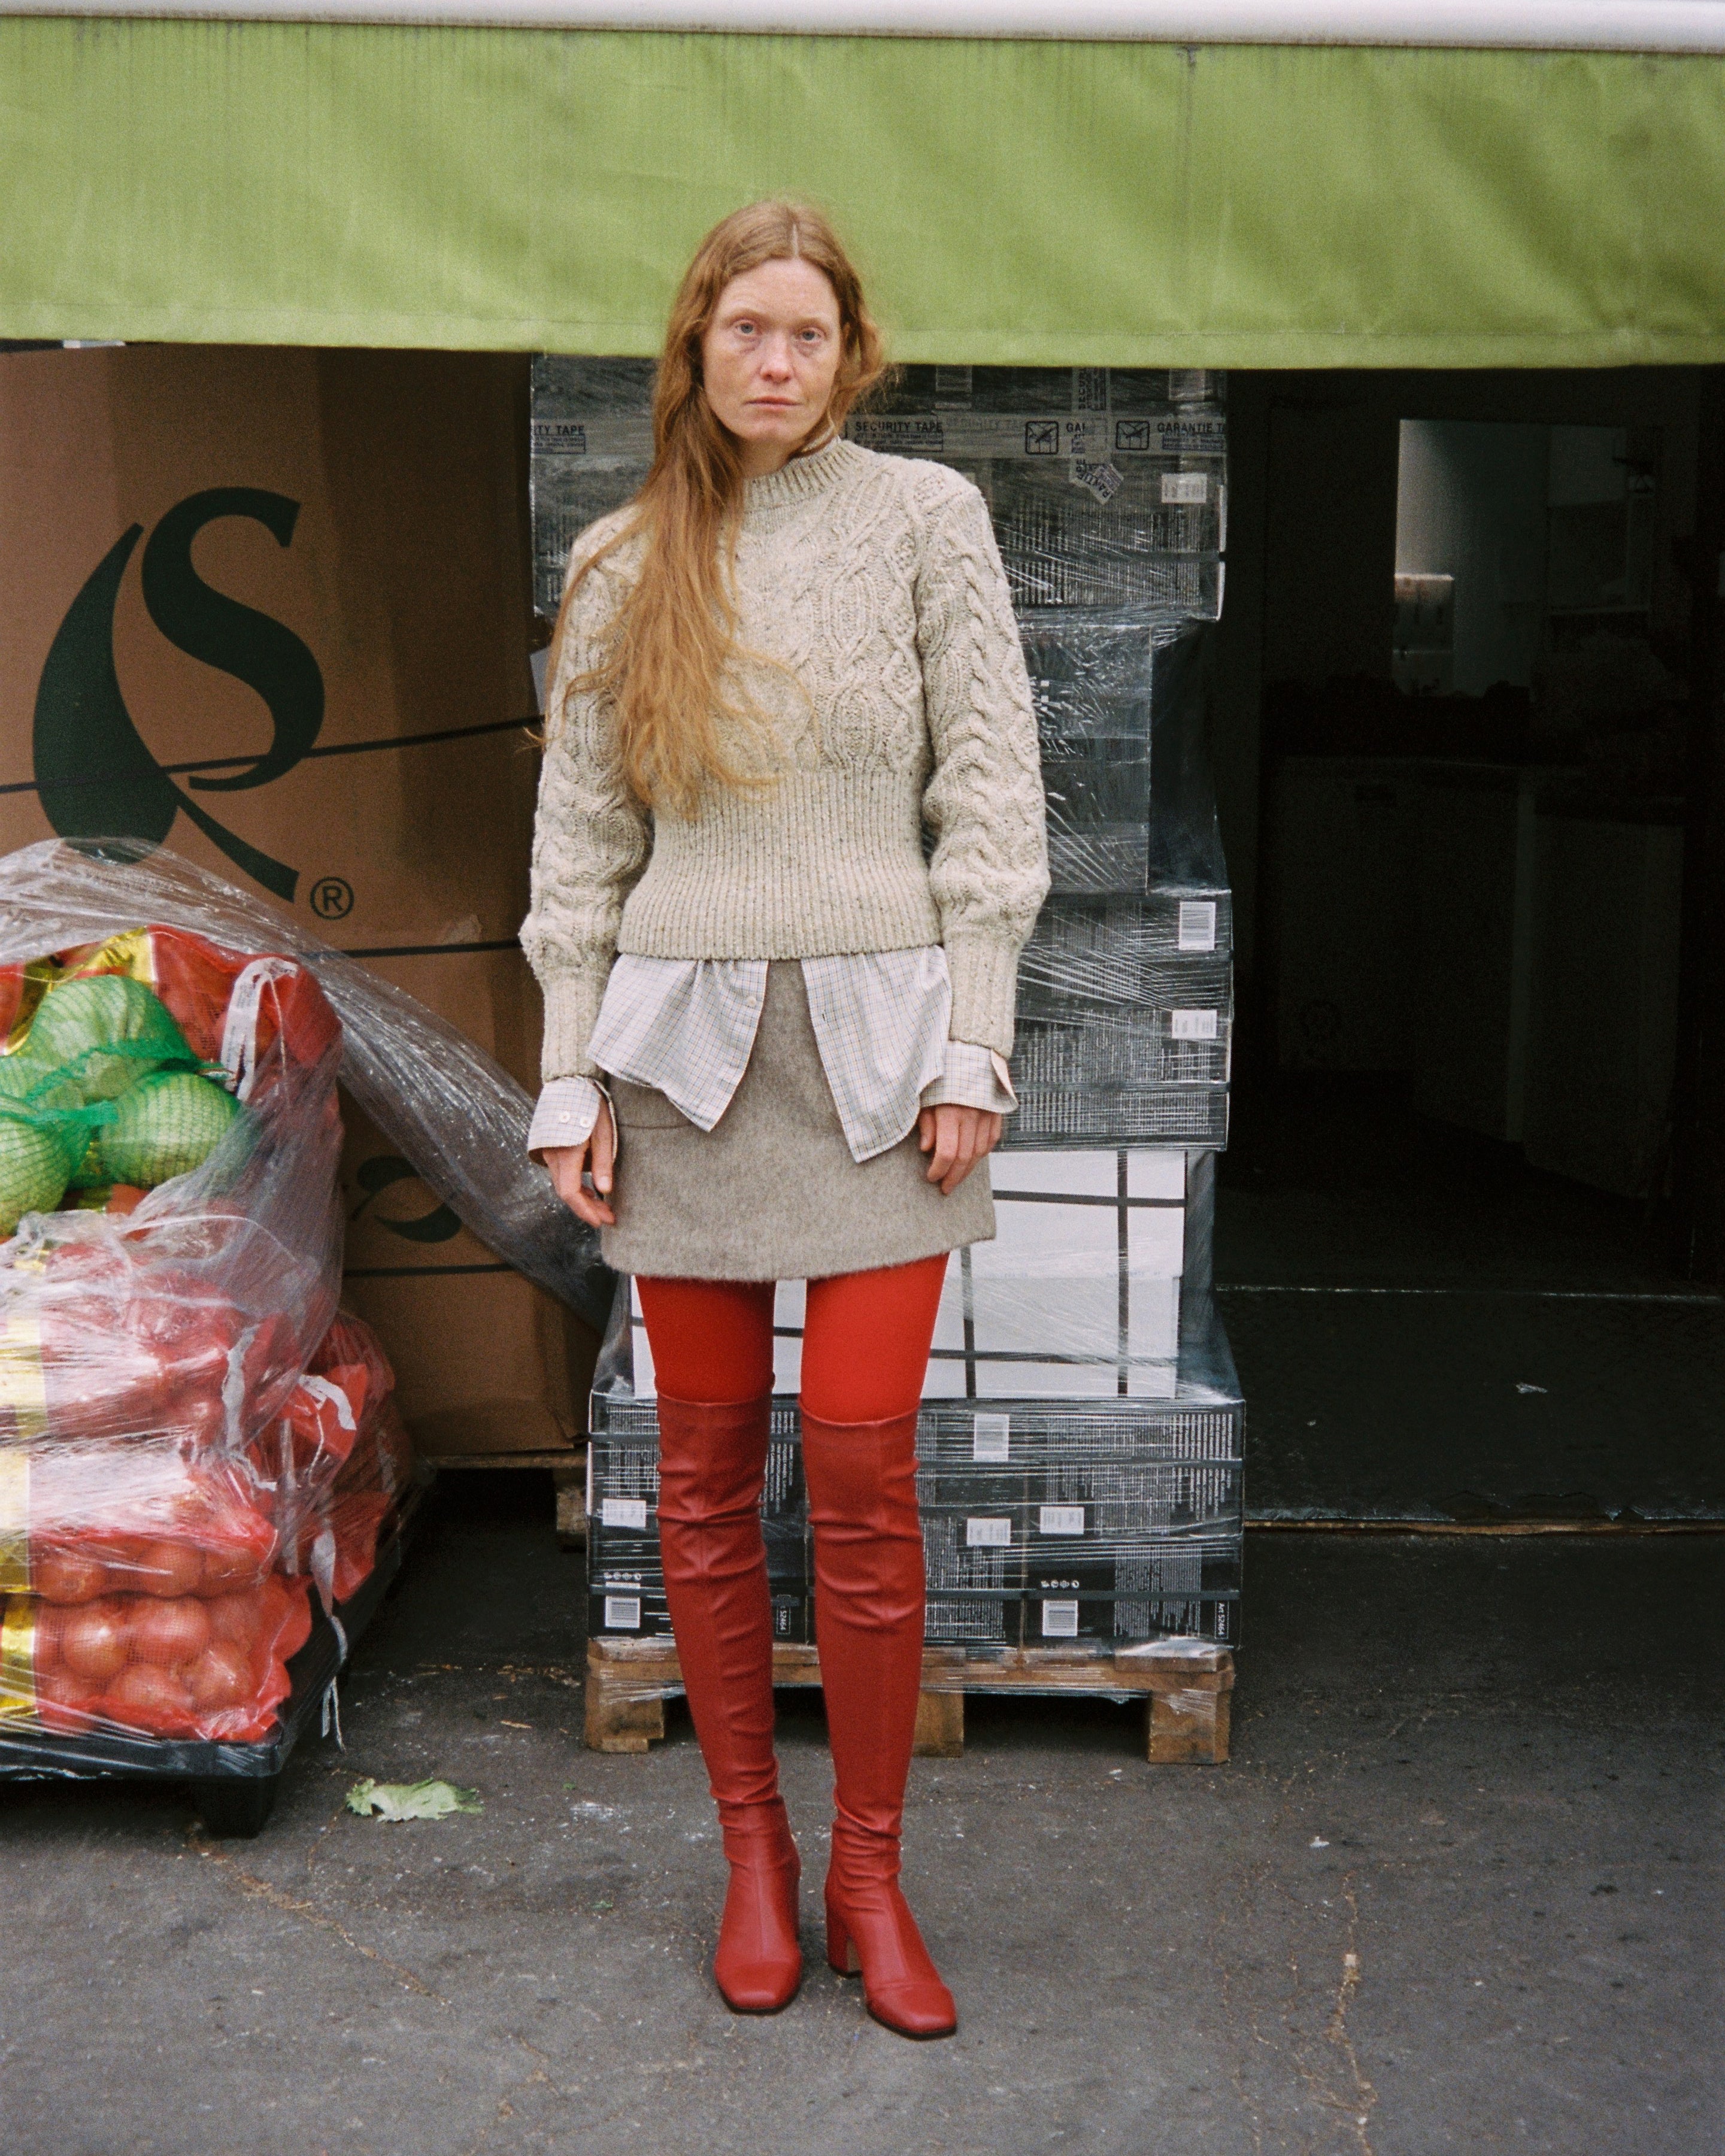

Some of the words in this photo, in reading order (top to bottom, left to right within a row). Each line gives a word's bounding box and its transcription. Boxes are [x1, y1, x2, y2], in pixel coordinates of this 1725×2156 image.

[556, 425, 585, 436] TAPE
[856, 421, 911, 433] SECURITY
[915, 421, 943, 433] TAPE
[1157, 422, 1213, 433] GARANTIE
